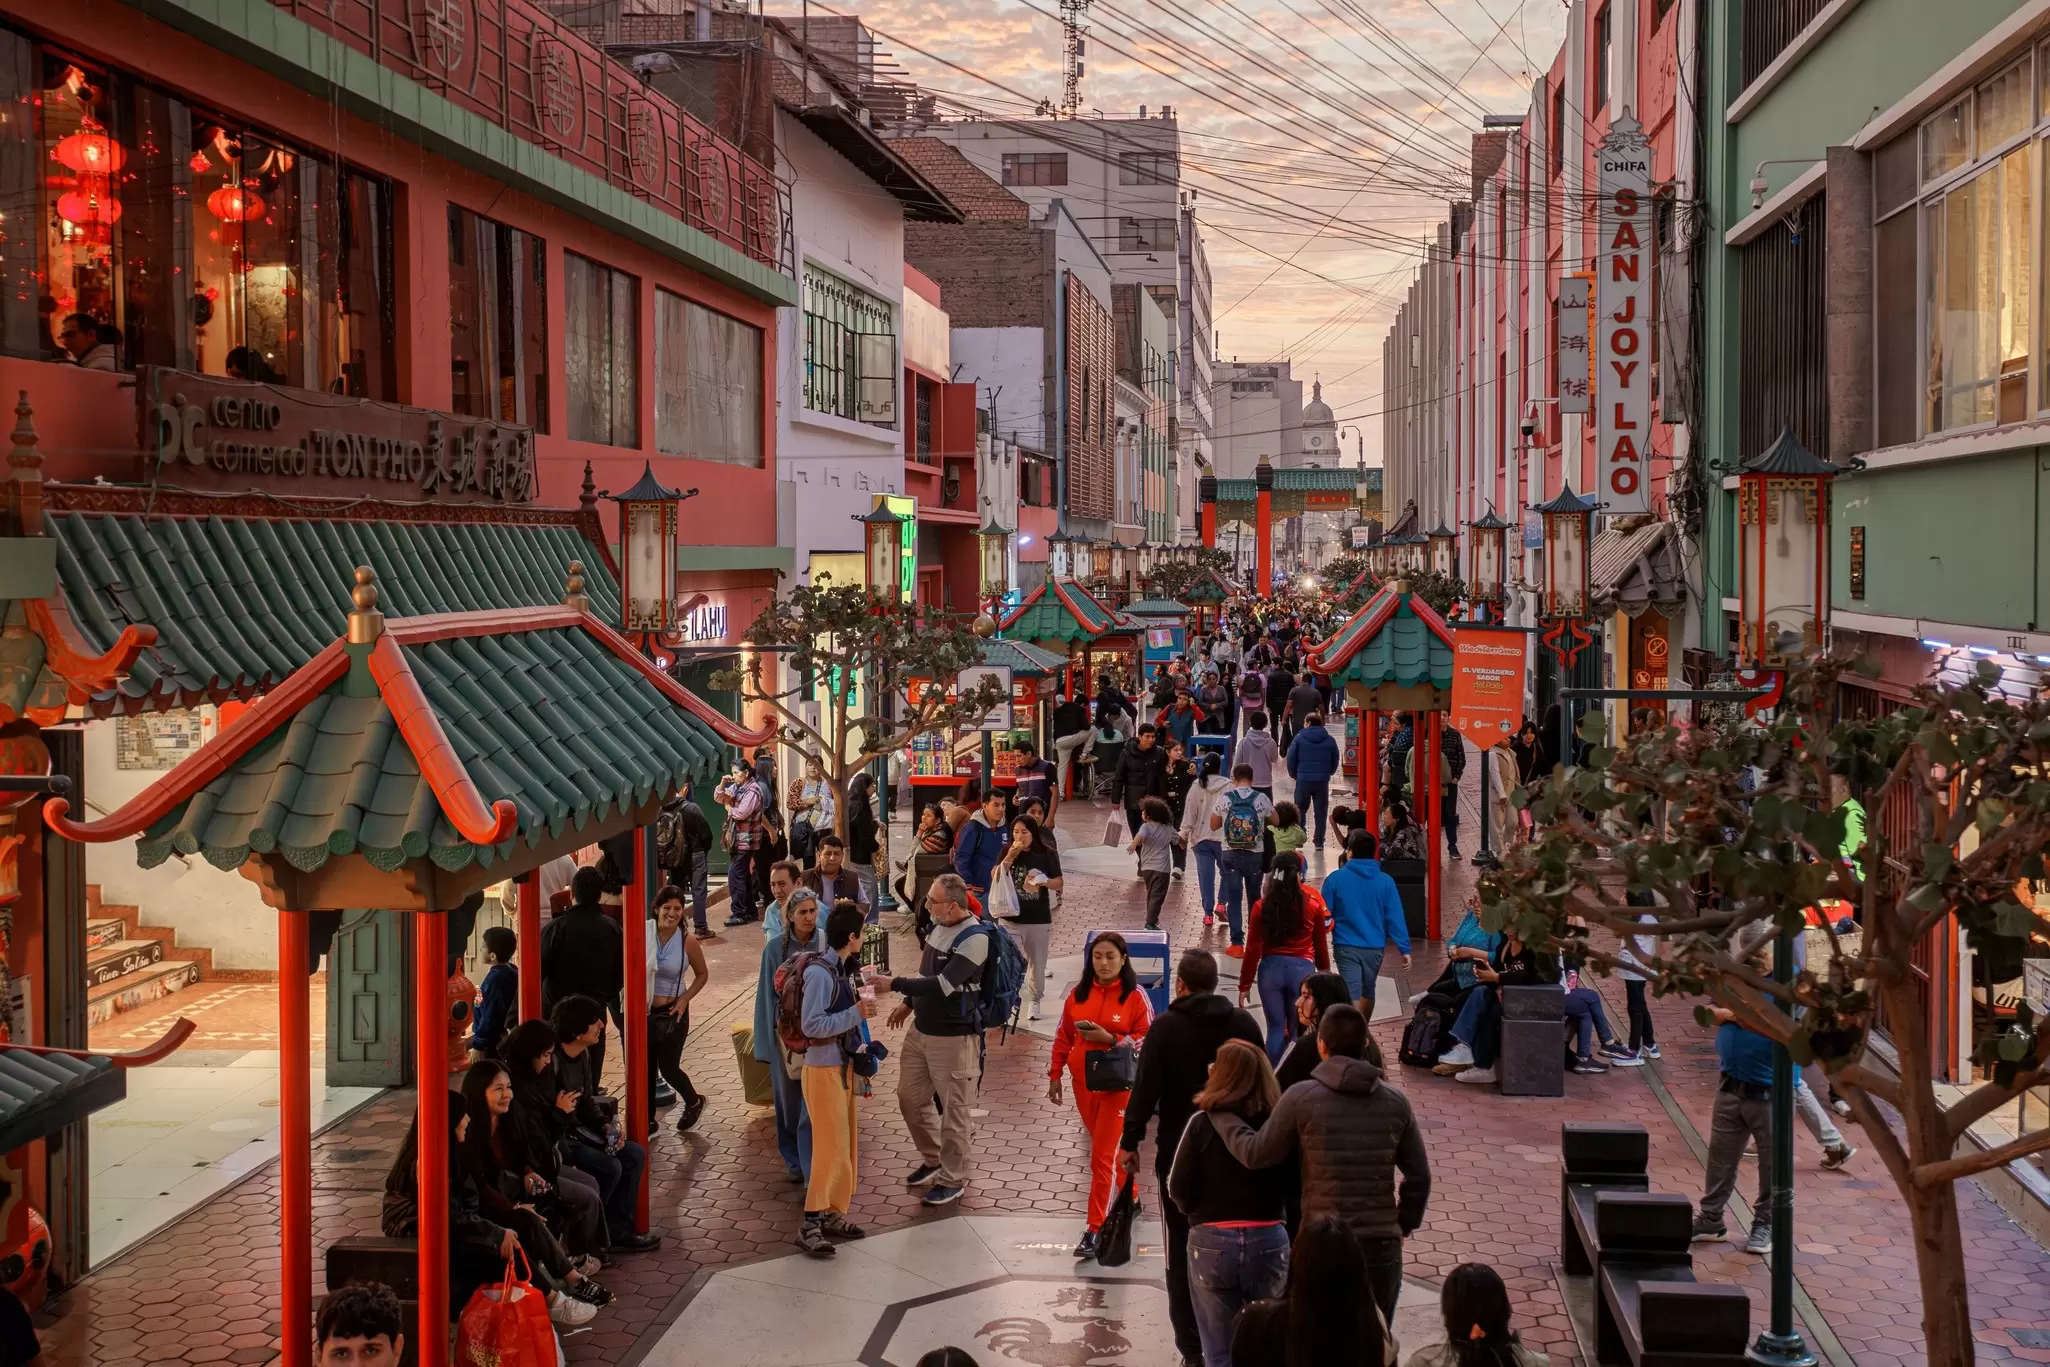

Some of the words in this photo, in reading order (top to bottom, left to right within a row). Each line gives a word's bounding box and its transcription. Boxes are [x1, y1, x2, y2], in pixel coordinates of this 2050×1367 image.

[1604, 161, 1647, 172] CHIFA
[1611, 188, 1640, 281] SAN
[1610, 296, 1639, 388] JOY
[211, 394, 281, 430] centro
[310, 428, 369, 477] TON
[375, 434, 425, 482] PHO
[1610, 403, 1639, 495] LAO
[1472, 668, 1515, 676] VERDADERO
[94, 966, 120, 984] Tina
